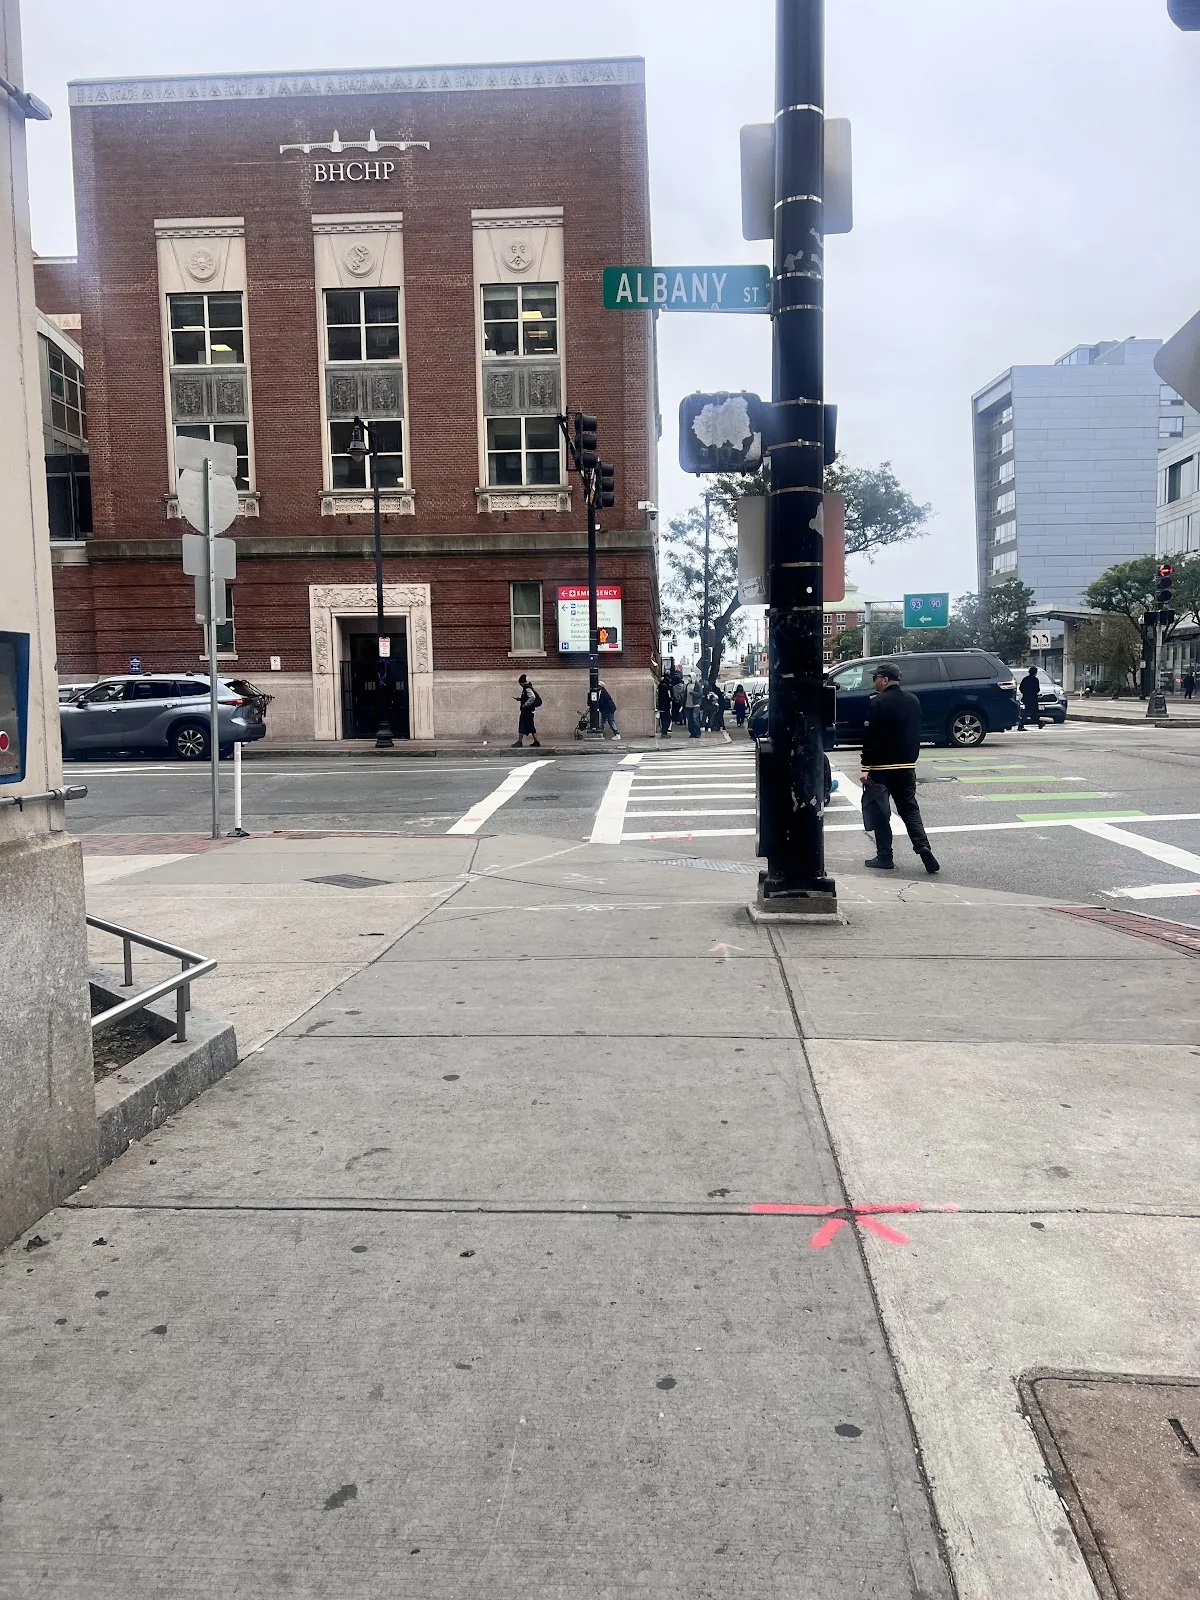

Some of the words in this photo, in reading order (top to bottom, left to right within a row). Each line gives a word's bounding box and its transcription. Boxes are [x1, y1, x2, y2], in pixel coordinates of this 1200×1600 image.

[313, 161, 395, 182] BHCHP
[615, 272, 728, 303] ALBANY
[743, 287, 759, 302] ST
[911, 601, 921, 609] 93
[931, 600, 941, 608] 90
